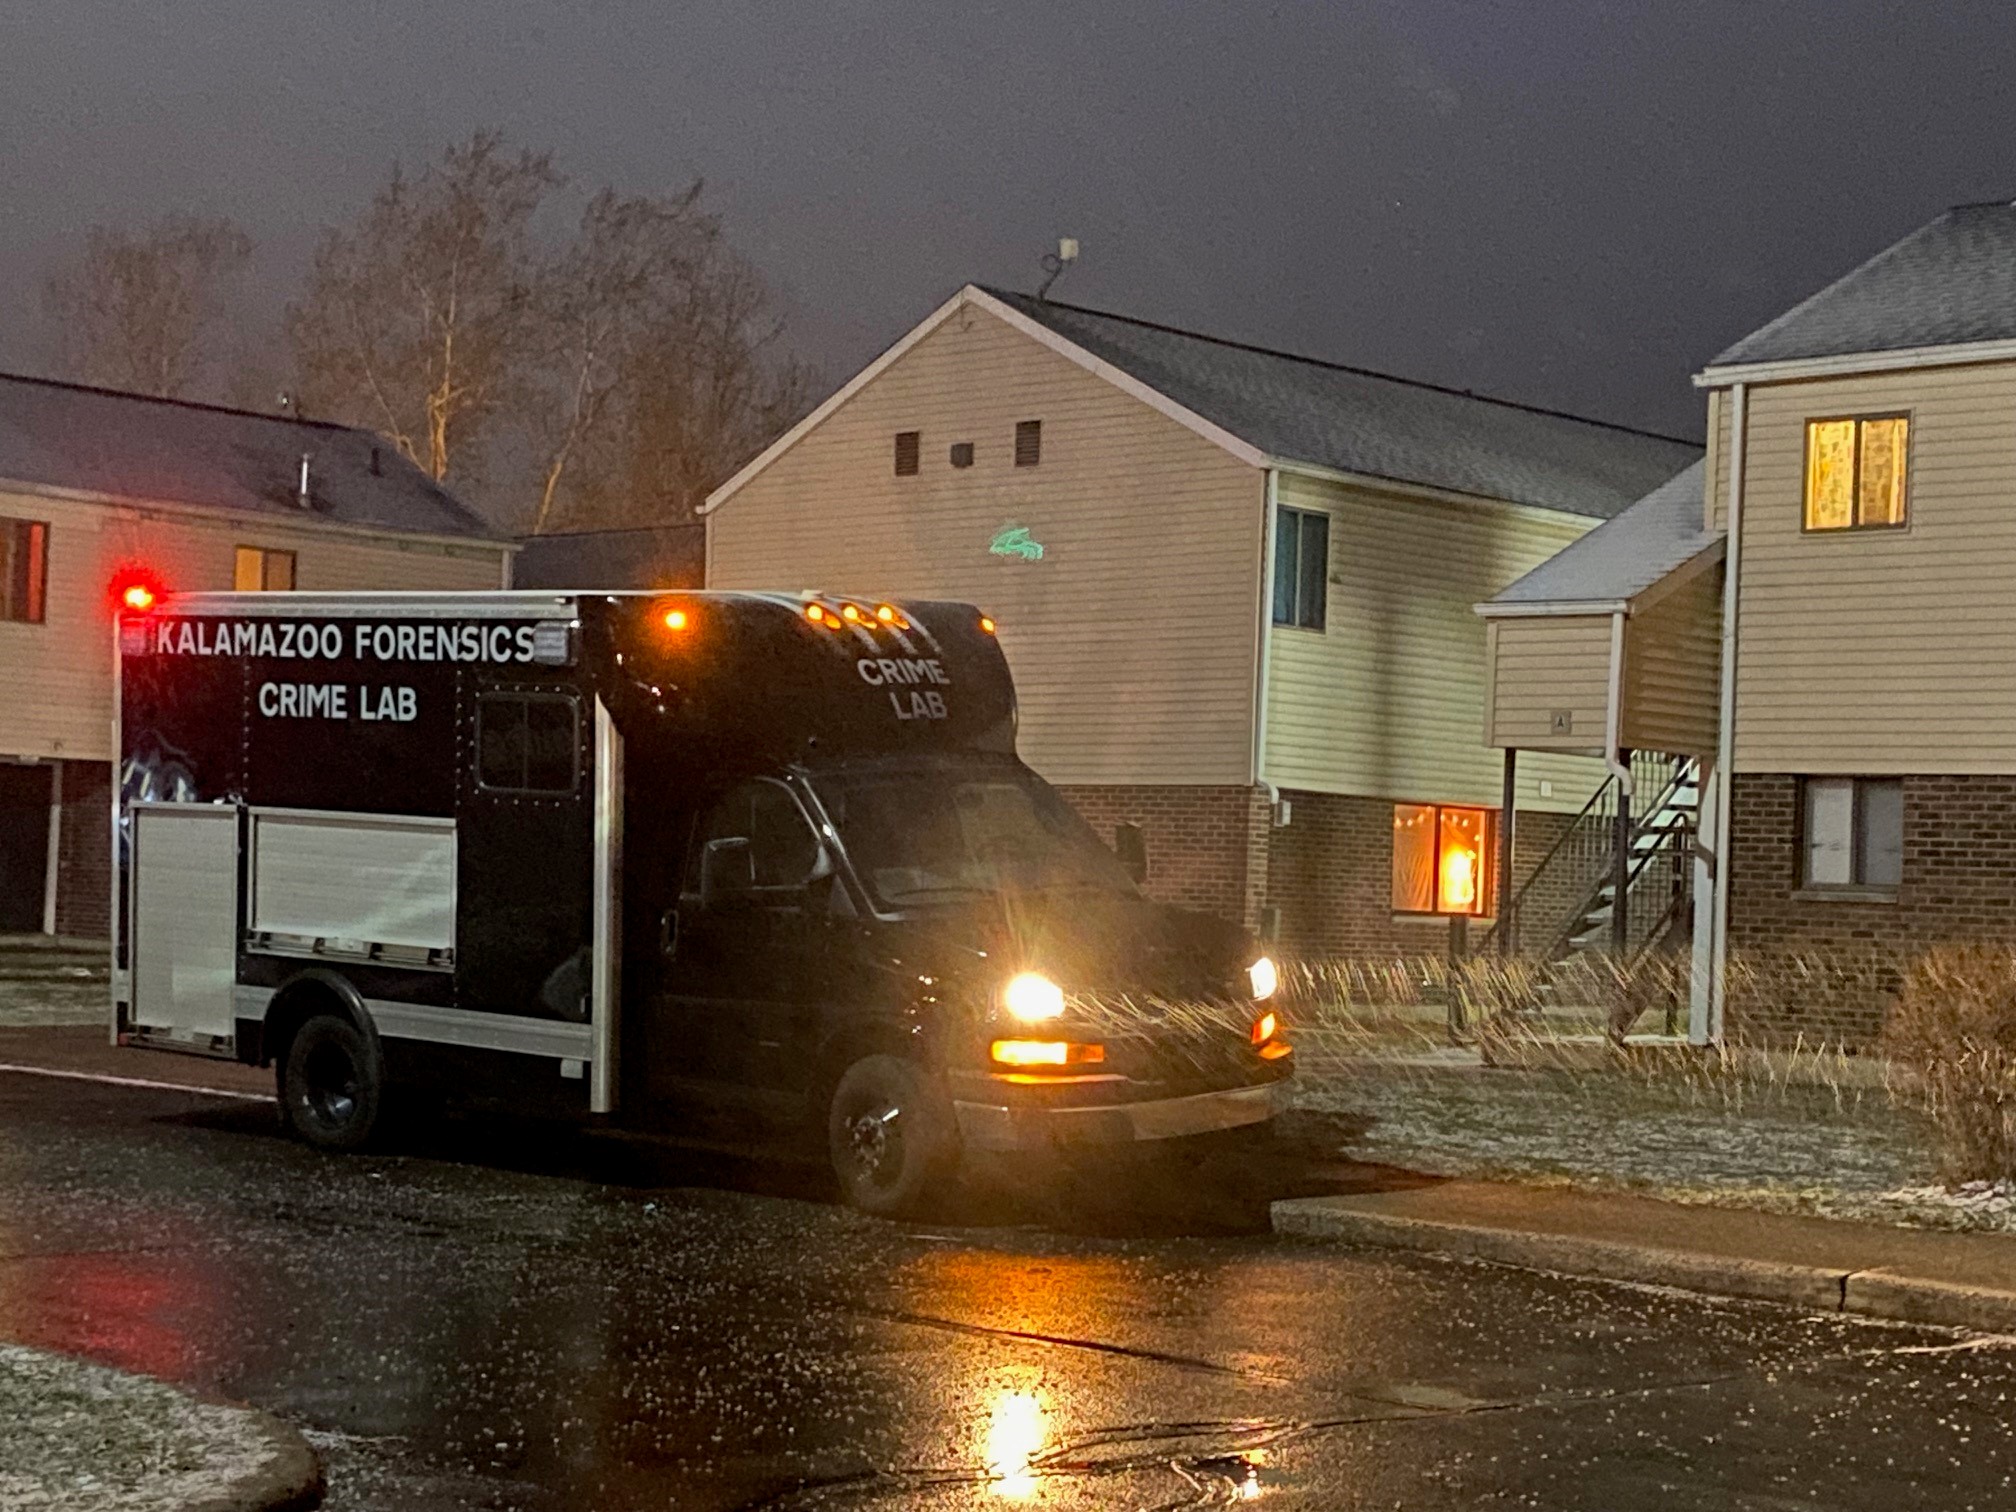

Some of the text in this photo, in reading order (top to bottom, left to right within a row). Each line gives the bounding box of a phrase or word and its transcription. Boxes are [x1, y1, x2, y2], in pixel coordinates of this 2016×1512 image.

[157, 621, 535, 662] KALAMAZOO FORENSICS
[857, 658, 950, 685] CRIME
[259, 682, 417, 721] CRIME LAB
[890, 691, 948, 719] LAB
